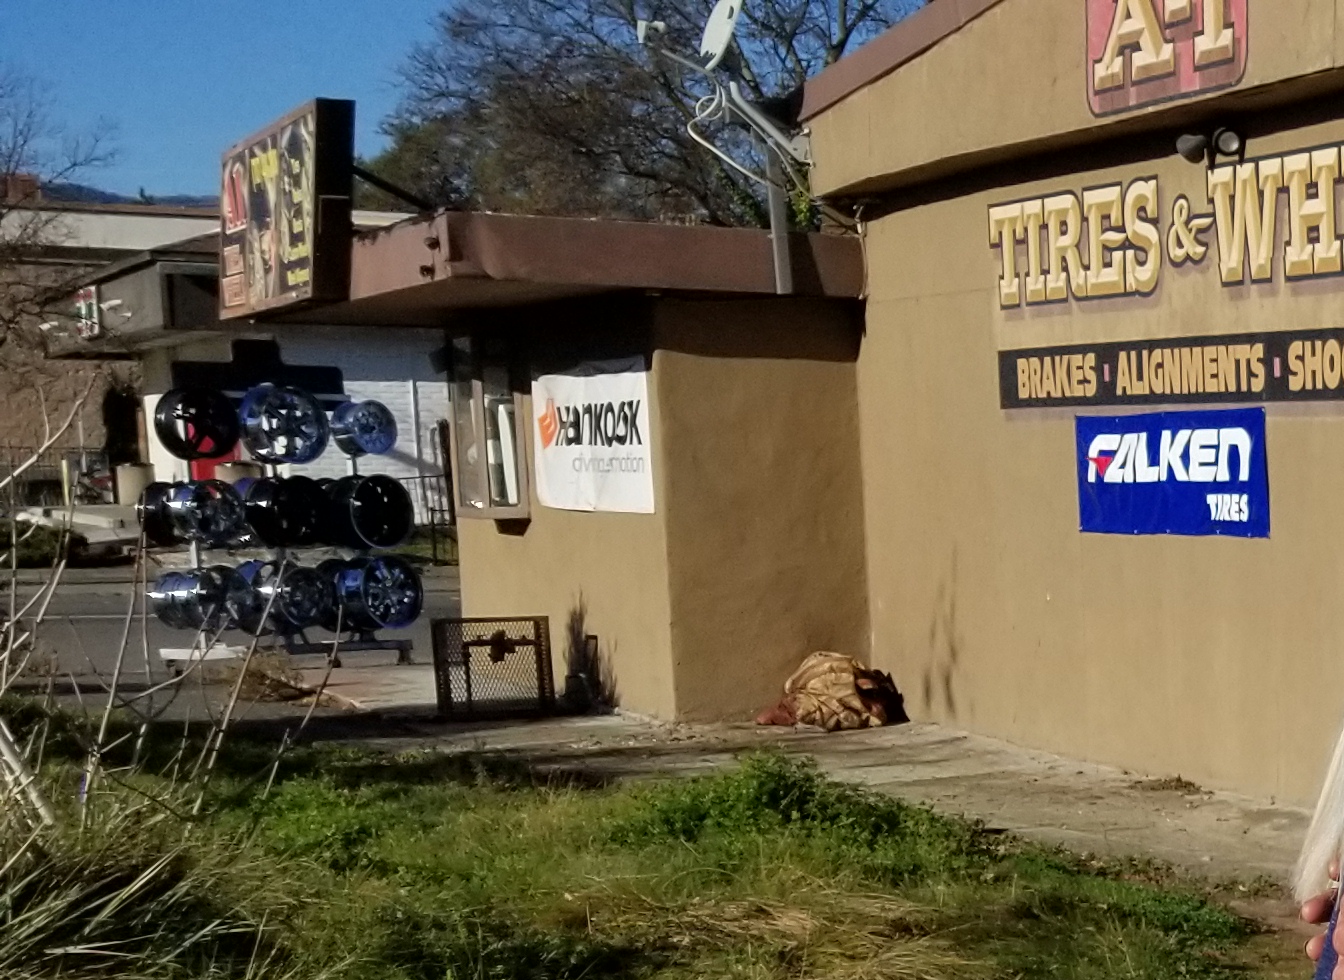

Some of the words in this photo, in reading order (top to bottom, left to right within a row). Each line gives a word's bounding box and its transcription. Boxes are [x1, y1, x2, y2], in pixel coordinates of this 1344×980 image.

[987, 176, 1161, 307] TIRES
[1167, 195, 1215, 263] &
[1016, 352, 1098, 399] BRAKES
[1115, 342, 1266, 396] ALIGNMENTS
[1086, 426, 1252, 484] FALKEN
[1205, 493, 1250, 523] TIRES
